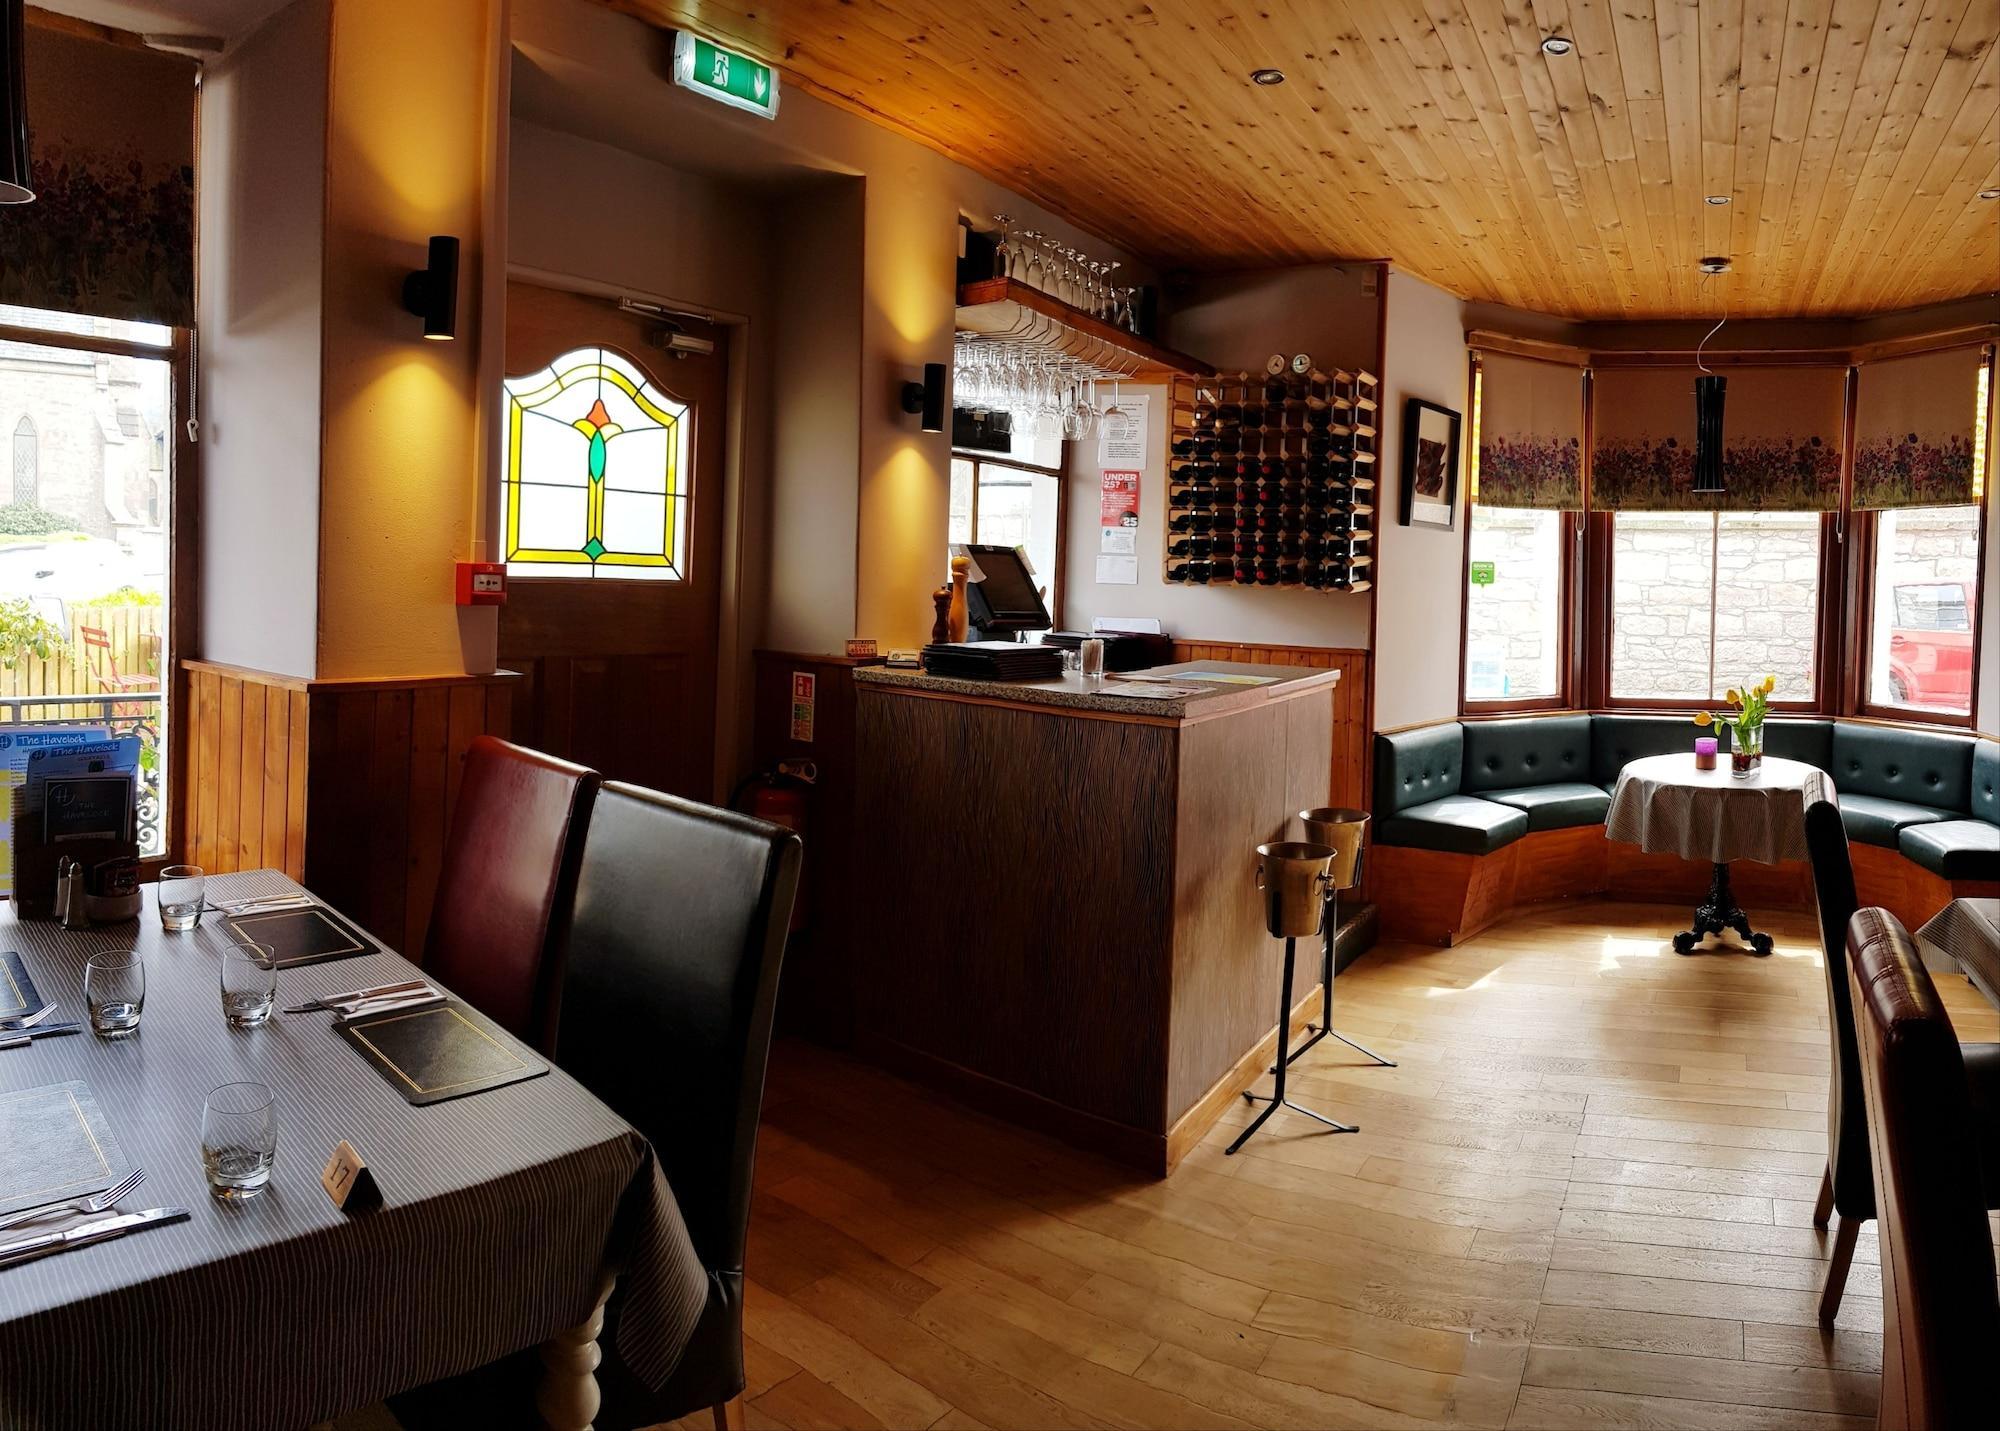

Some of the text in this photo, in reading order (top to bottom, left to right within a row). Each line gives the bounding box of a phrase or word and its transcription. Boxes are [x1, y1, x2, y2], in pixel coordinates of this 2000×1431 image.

[1104, 473, 1137, 481] UNDER
[1123, 517, 1138, 527] 25
[18, 734, 85, 745] The Havelock
[53, 743, 119, 756] The Havelock
[330, 1158, 350, 1189] 17
